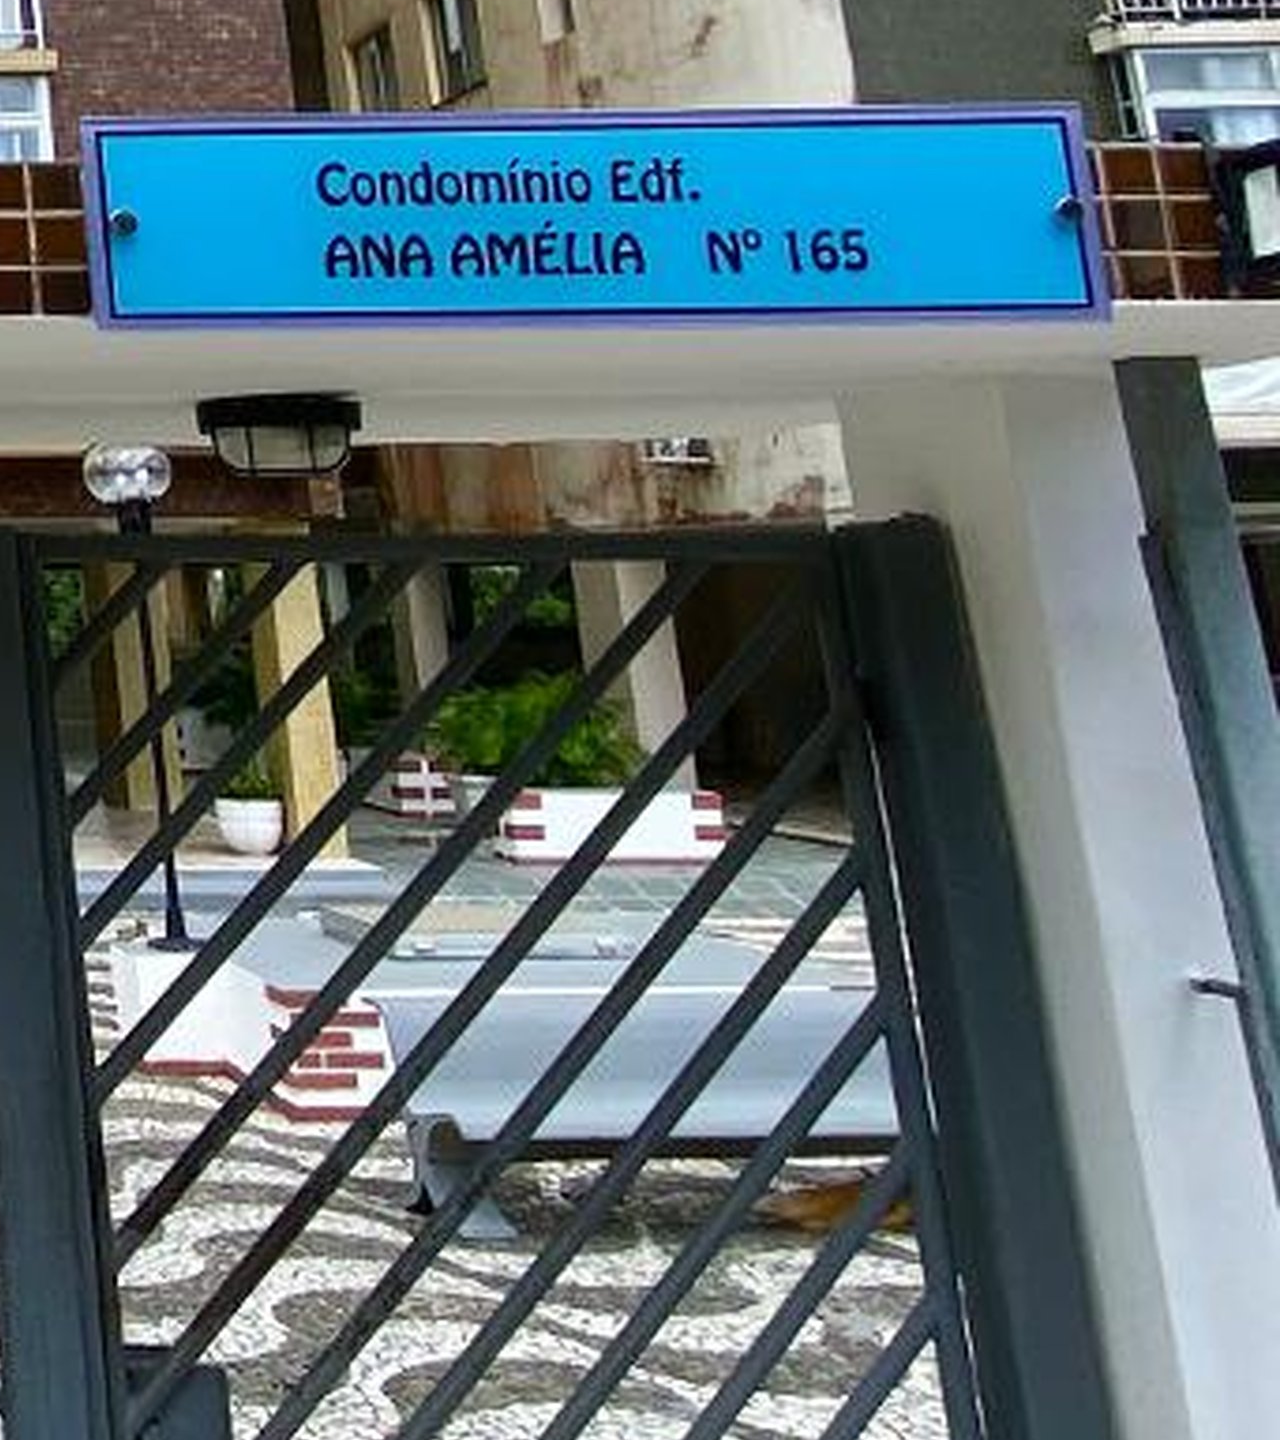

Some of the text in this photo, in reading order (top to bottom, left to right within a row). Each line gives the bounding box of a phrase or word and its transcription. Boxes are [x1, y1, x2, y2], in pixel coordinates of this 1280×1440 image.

[316, 157, 701, 206] Condomínio Edf.
[325, 233, 434, 279] ANA
[450, 220, 646, 277] AMÉLIA
[785, 228, 870, 274] 165
